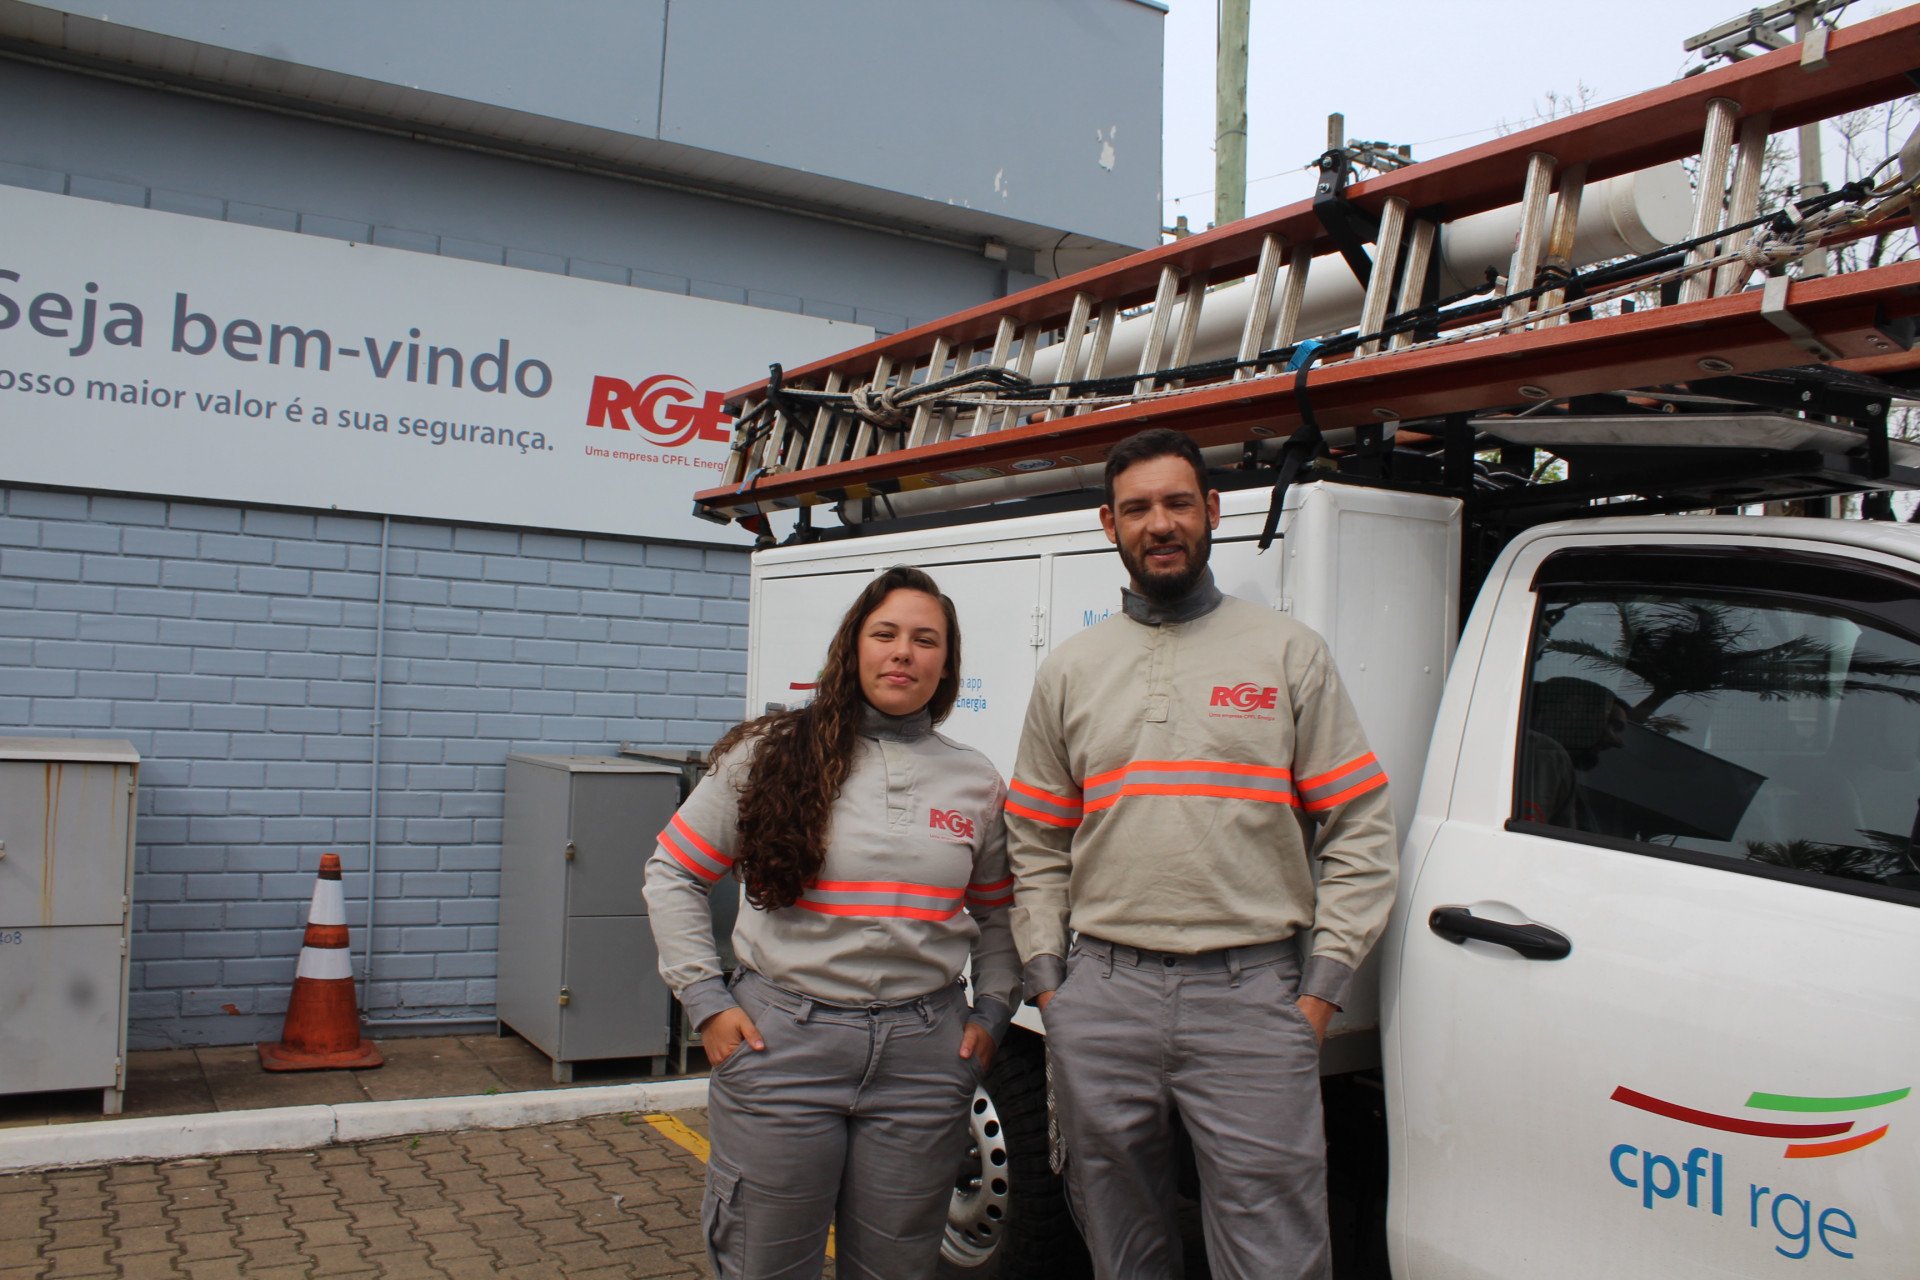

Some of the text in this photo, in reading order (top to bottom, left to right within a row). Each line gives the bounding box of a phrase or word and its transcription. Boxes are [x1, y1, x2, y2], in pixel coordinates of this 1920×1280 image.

[0, 268, 553, 399] Seja bem-vindo
[0, 369, 554, 455] osso maior valor é a sua segurança.
[586, 374, 734, 448] RGE
[585, 445, 727, 473] Uma empresa CPFL Energi
[1083, 608, 1114, 627] Mud
[966, 678, 982, 692] app
[1209, 682, 1278, 712] RGE
[929, 808, 975, 839] RGE
[1609, 1143, 1858, 1260] cpfl rge
